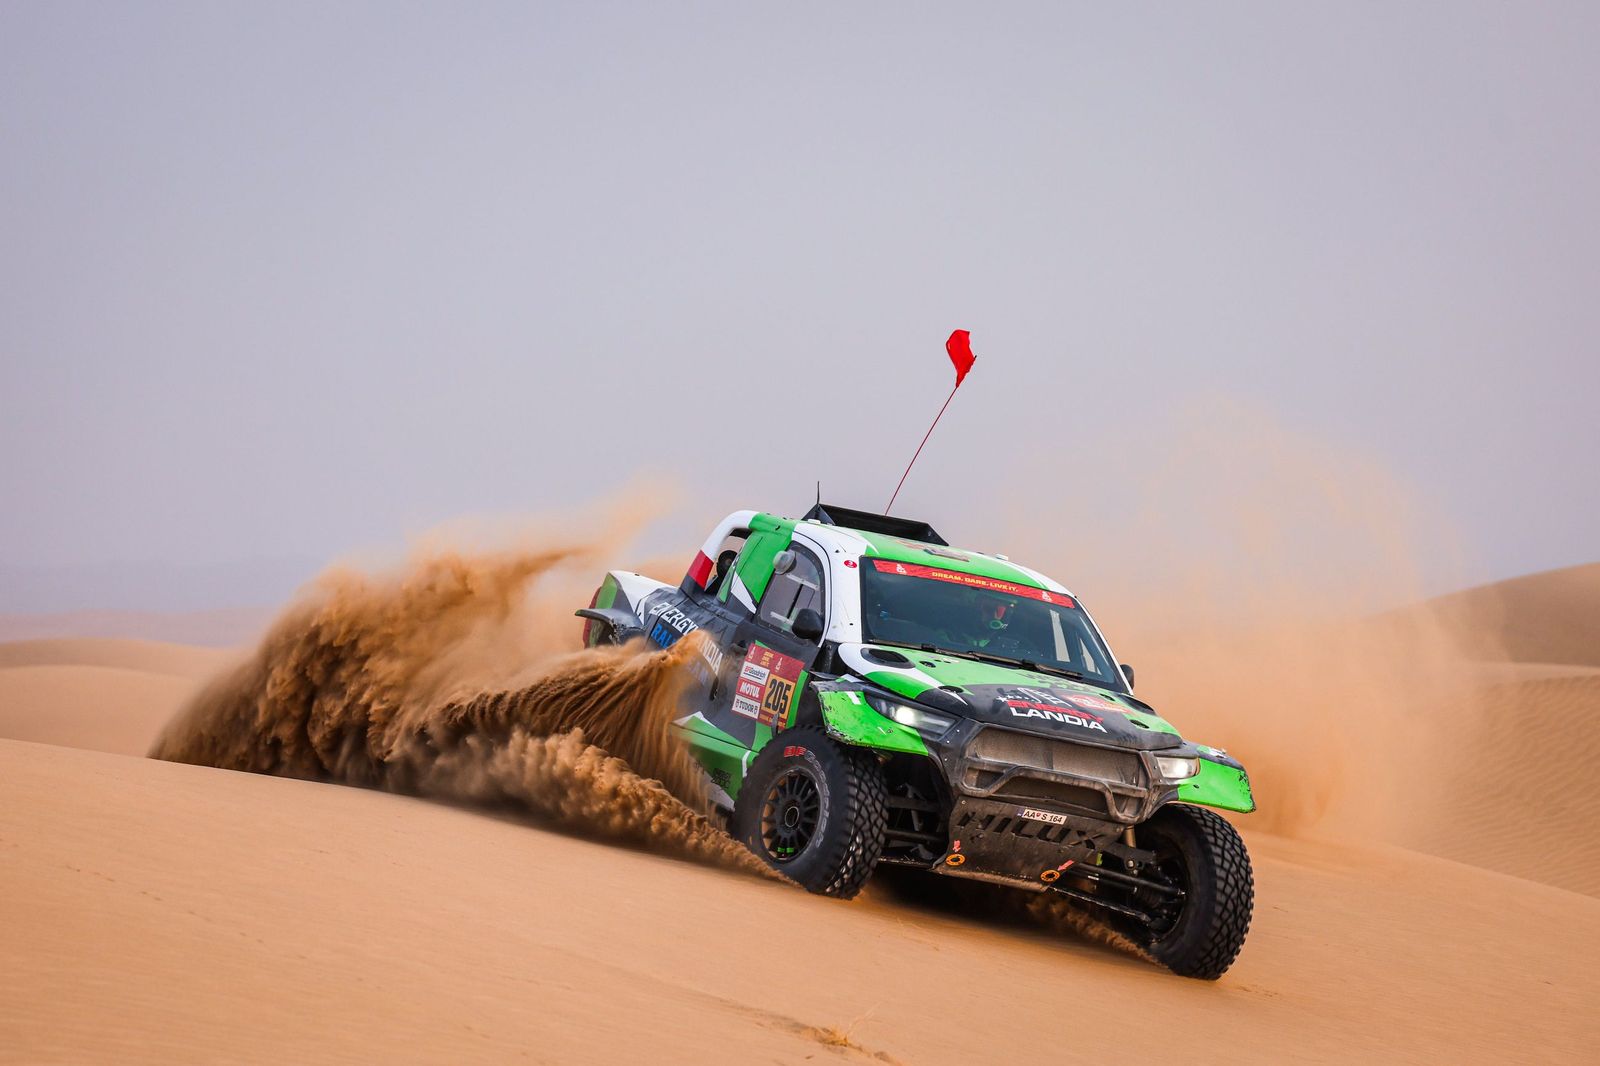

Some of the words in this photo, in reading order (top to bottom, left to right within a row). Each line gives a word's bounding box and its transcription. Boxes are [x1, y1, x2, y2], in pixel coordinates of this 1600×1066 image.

[932, 571, 964, 582] DREAM.
[964, 576, 989, 587] DARE.
[989, 582, 1008, 590] LIVE
[744, 665, 767, 679] BFGoodrich
[739, 681, 761, 699] MOTUL
[764, 678, 792, 715] 205
[1009, 707, 1108, 734] LANDIA
[1023, 810, 1036, 819] AA
[1041, 812, 1048, 821] S
[1049, 814, 1063, 824] 164
